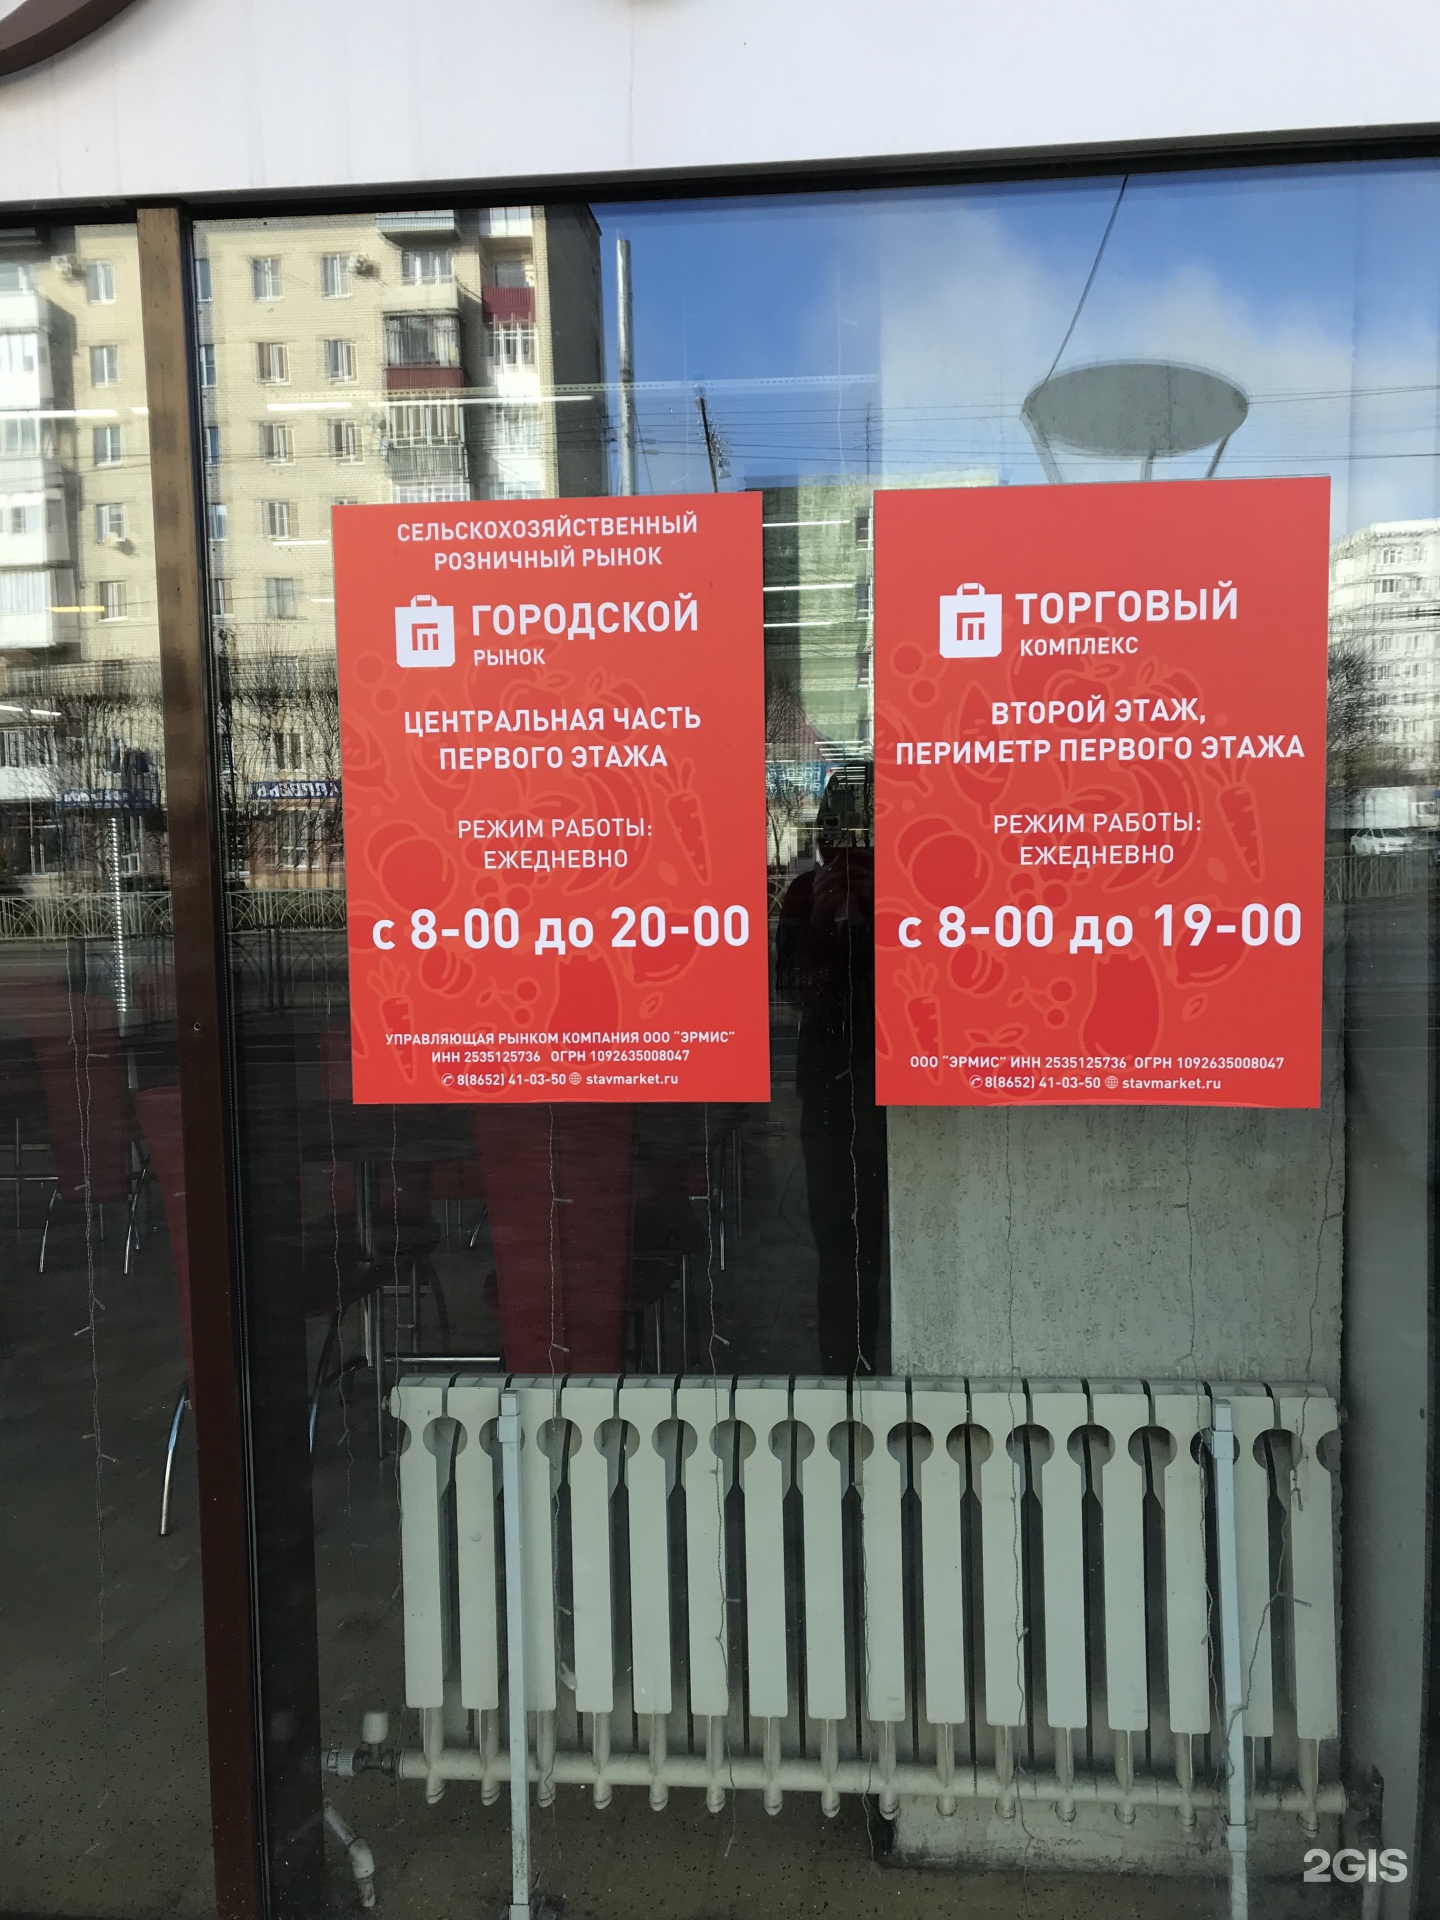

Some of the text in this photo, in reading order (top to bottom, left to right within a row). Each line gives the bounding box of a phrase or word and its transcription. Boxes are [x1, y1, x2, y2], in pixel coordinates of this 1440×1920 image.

[398, 511, 696, 541] СЕЛЬСКОХОЗЯЙСТВЕННЫЙ
[435, 545, 662, 570] РОЗНИЧНЫЙ РЫНОК
[1015, 580, 1237, 624] ТОРГОВЫЙ
[472, 593, 697, 640] ГОРОДСКОЙ
[474, 649, 545, 666] РЫНОК
[1021, 637, 1138, 656] КОМПЛЕКС
[992, 695, 1205, 724] ВТОРОЙ ЭТАЖ,
[405, 707, 700, 737] ЦЕНТРАЛЬНАЯ ЧАСТЬ
[440, 745, 667, 769] ПЕРВОГО ЭТАЖА
[897, 735, 1304, 764] ПЕРИМЕТР ПЕРВОГО ЭТАЖА
[459, 818, 651, 838] РЕЖИМ РАБОТЫ:
[995, 812, 1200, 833] РЕЖИМ РАБОТЫ:
[485, 849, 627, 872] ЕЖЕДНЕВНО
[1021, 845, 1173, 868] ЕЖЕДНЕВНО
[373, 905, 749, 955] с 8-00 до 20-00
[899, 903, 1301, 954] с 8-00 до 19-00
[386, 1033, 494, 1046] УПРАВЛЯЮЩАЯ
[499, 1033, 558, 1044] РЫНКОМ
[563, 1032, 638, 1043] КОМПАНИЯ
[644, 1032, 669, 1043] ООО
[432, 1050, 689, 1062] ИНН 2535125736 ОГРН 1092635008047
[911, 1056, 938, 1067] ООО
[1011, 1057, 1040, 1067] ИНН
[1046, 1057, 1126, 1068] 2535125736
[1135, 1057, 1171, 1068] ОГРН
[1178, 1057, 1284, 1068] 1092635008047
[458, 1074, 678, 1086] 8(8652) 41-03-50 stavmarket.ru
[985, 1076, 1220, 1088] 8(8652) 41-03-50 stavmarket.ru
